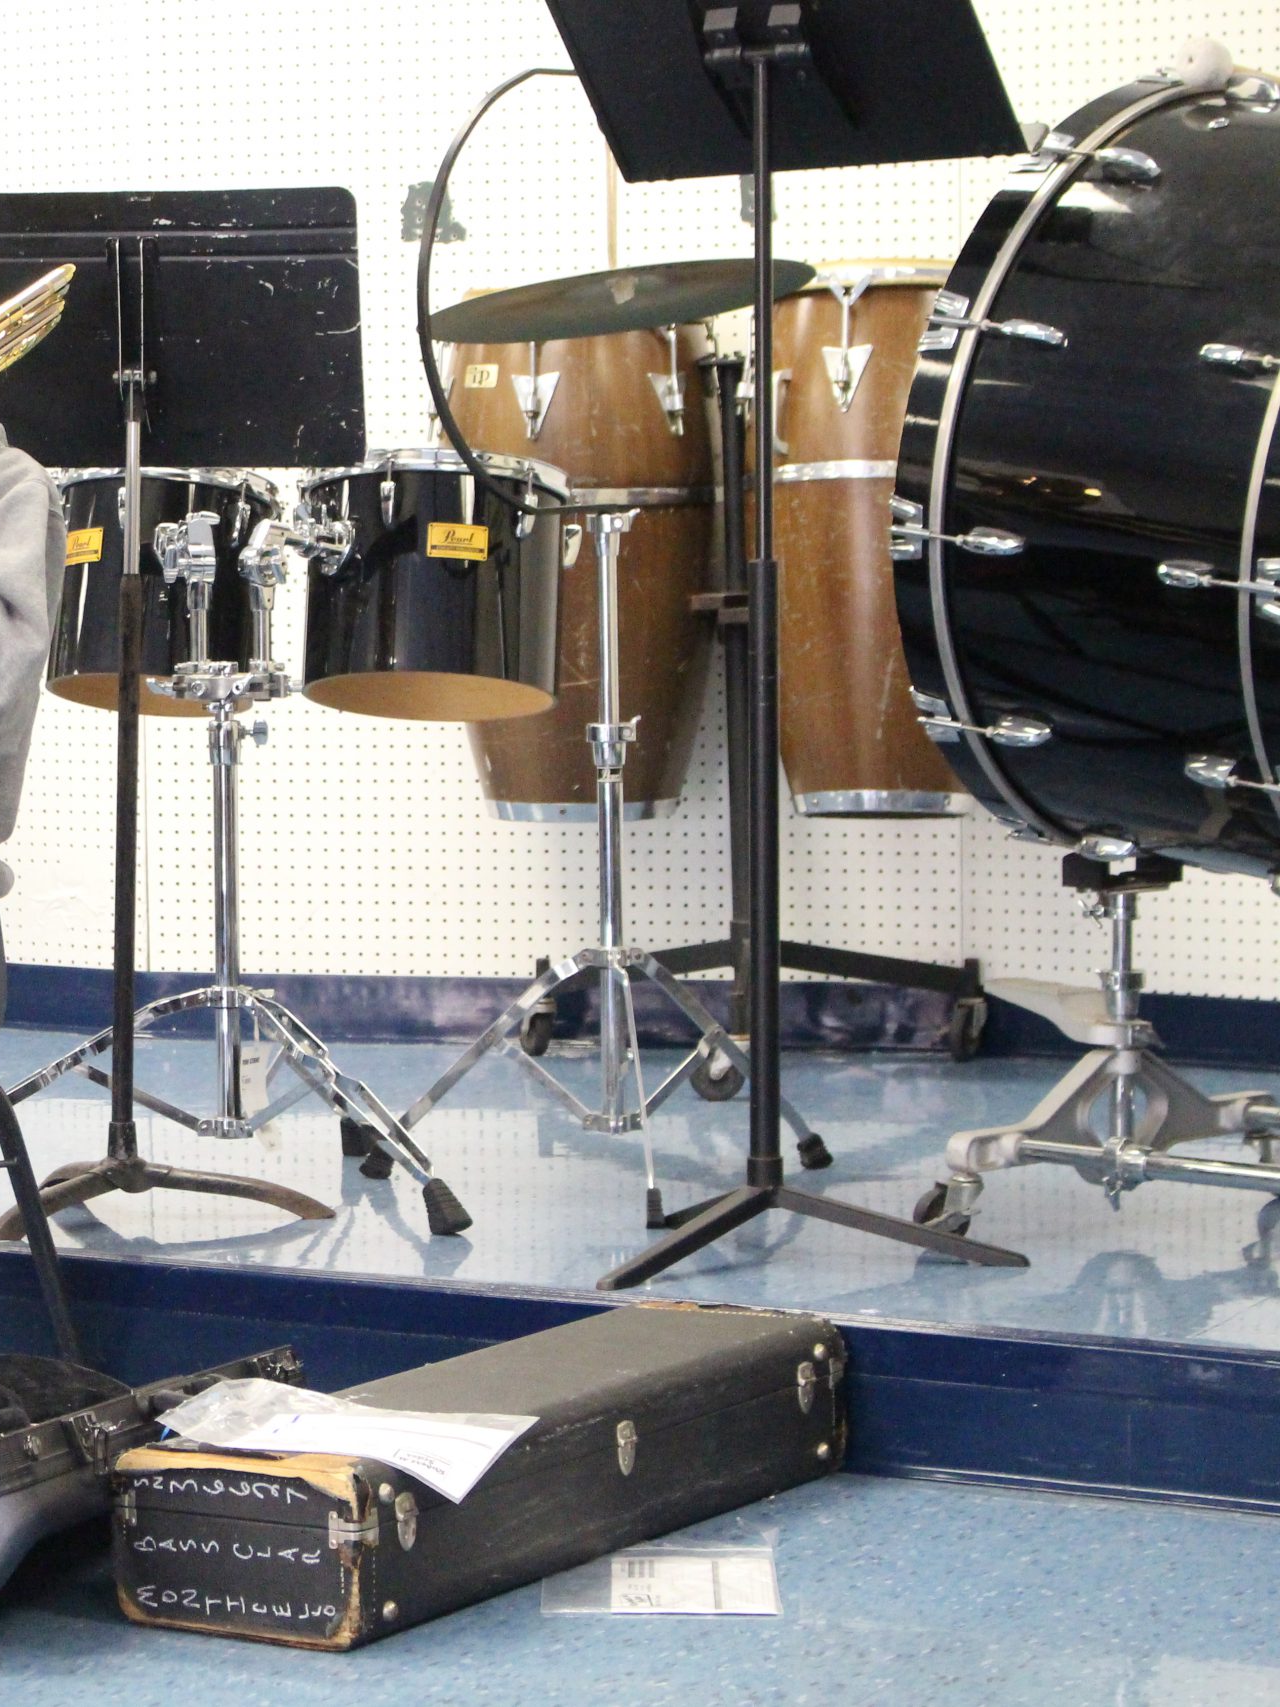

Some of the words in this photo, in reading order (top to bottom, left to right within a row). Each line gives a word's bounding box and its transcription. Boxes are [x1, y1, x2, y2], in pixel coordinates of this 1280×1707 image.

[440, 529, 474, 544] Pearl
[133, 1535, 219, 1554] BASS
[232, 1543, 321, 1564] CLAR
[135, 1584, 336, 1619] MONTICELLO
